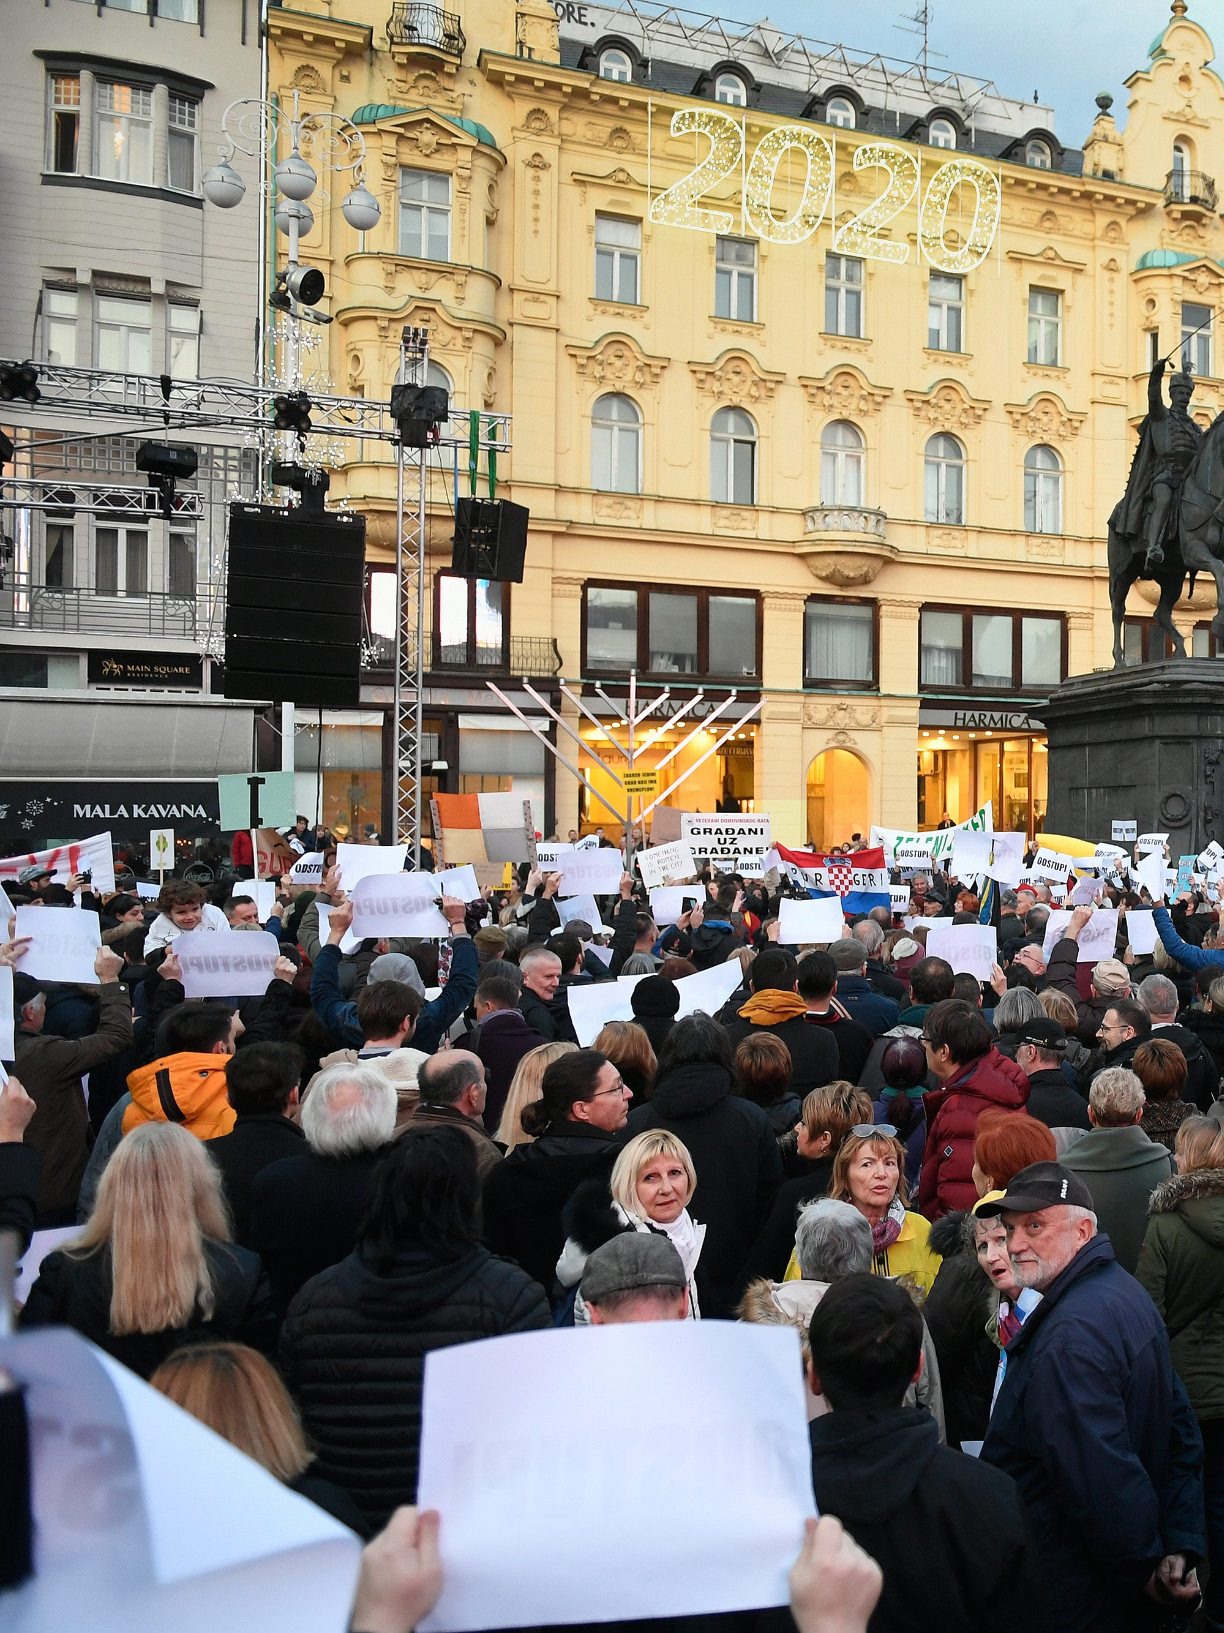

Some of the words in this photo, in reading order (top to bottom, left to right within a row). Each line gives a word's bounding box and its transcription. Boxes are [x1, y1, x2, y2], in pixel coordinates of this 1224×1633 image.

[548, 0, 595, 27] ORE.
[649, 107, 1001, 274] 2020
[127, 664, 151, 672] MAIN
[153, 665, 191, 674] SQUARE
[954, 711, 1032, 729] HARMICA
[73, 804, 129, 818] MALA
[133, 804, 207, 818] KAVANA
[690, 827, 764, 836] GRAĐANI
[717, 837, 738, 845] UZ
[900, 849, 929, 858] ODSTUPI
[1036, 857, 1068, 873] ODSTUPI
